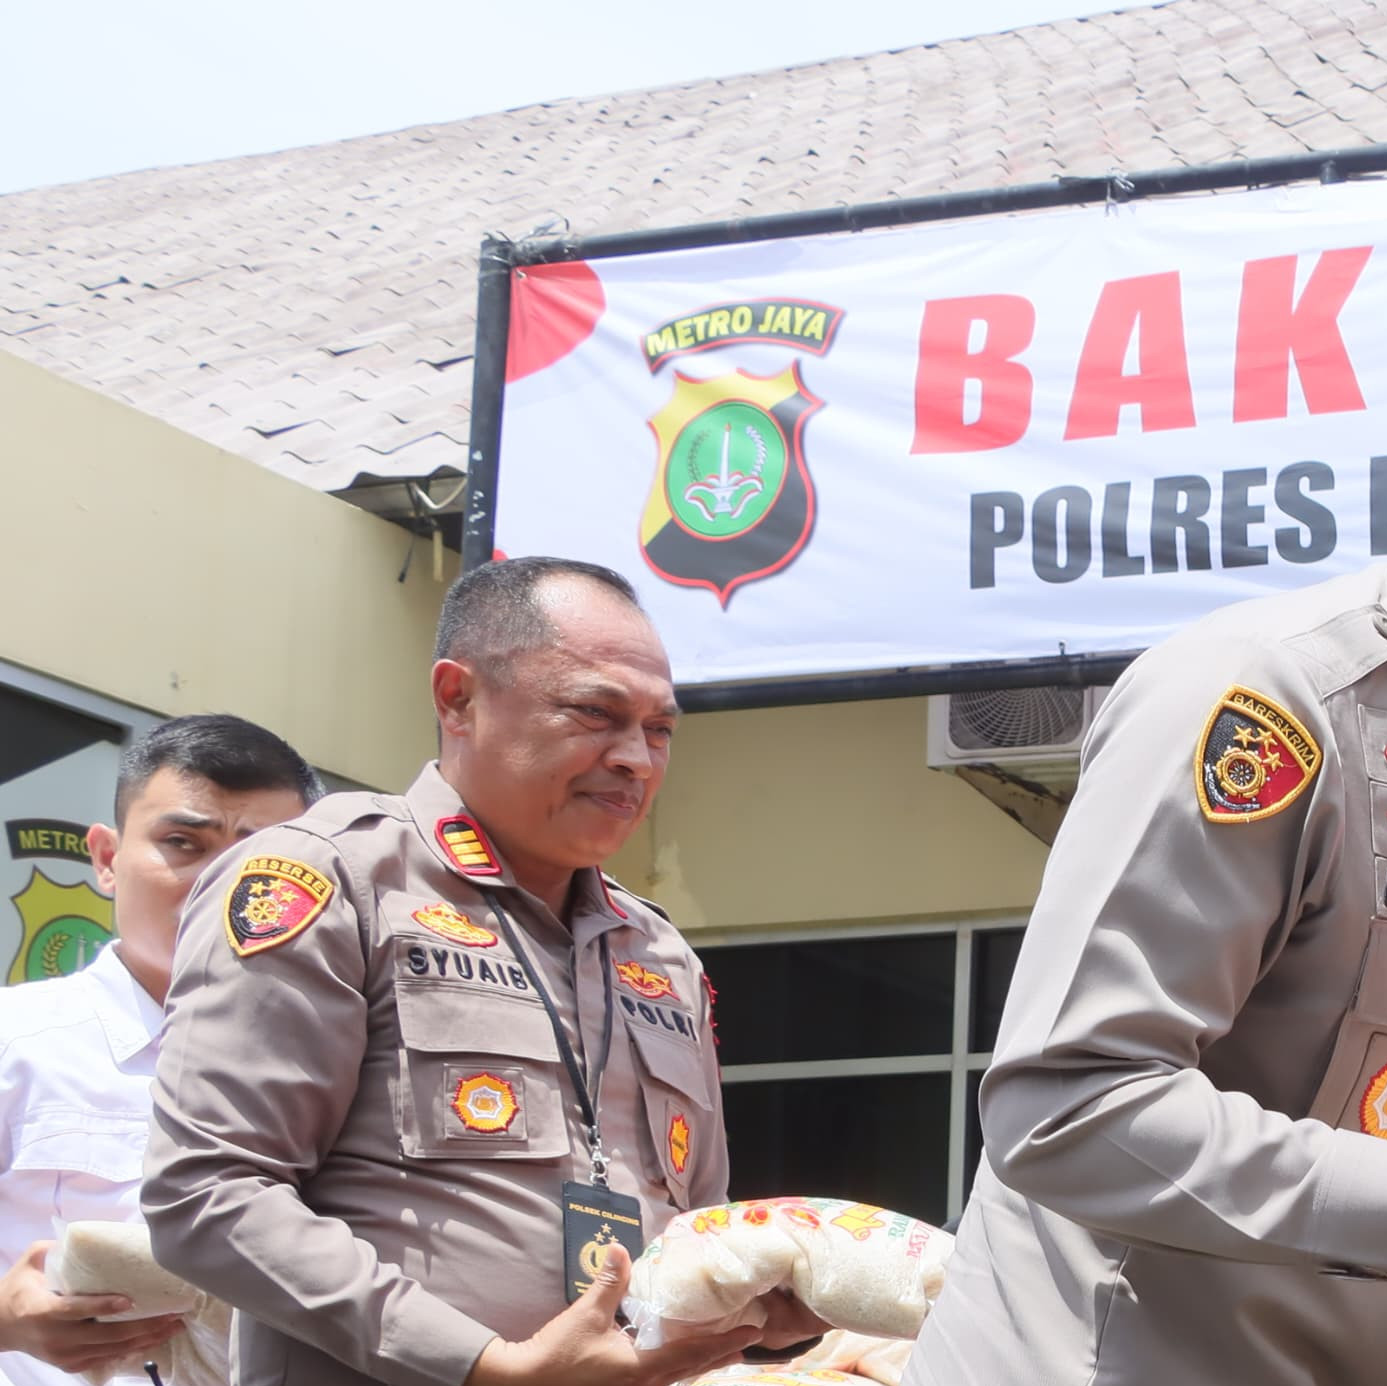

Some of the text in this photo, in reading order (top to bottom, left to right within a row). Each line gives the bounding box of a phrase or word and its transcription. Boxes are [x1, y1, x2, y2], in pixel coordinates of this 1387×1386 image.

[646, 304, 828, 357] METRO JAYA
[968, 460, 1335, 590] POLRES
[1232, 693, 1315, 764] BARESKRIM
[409, 946, 529, 991] SYUAIB
[620, 995, 698, 1042] POLRI
